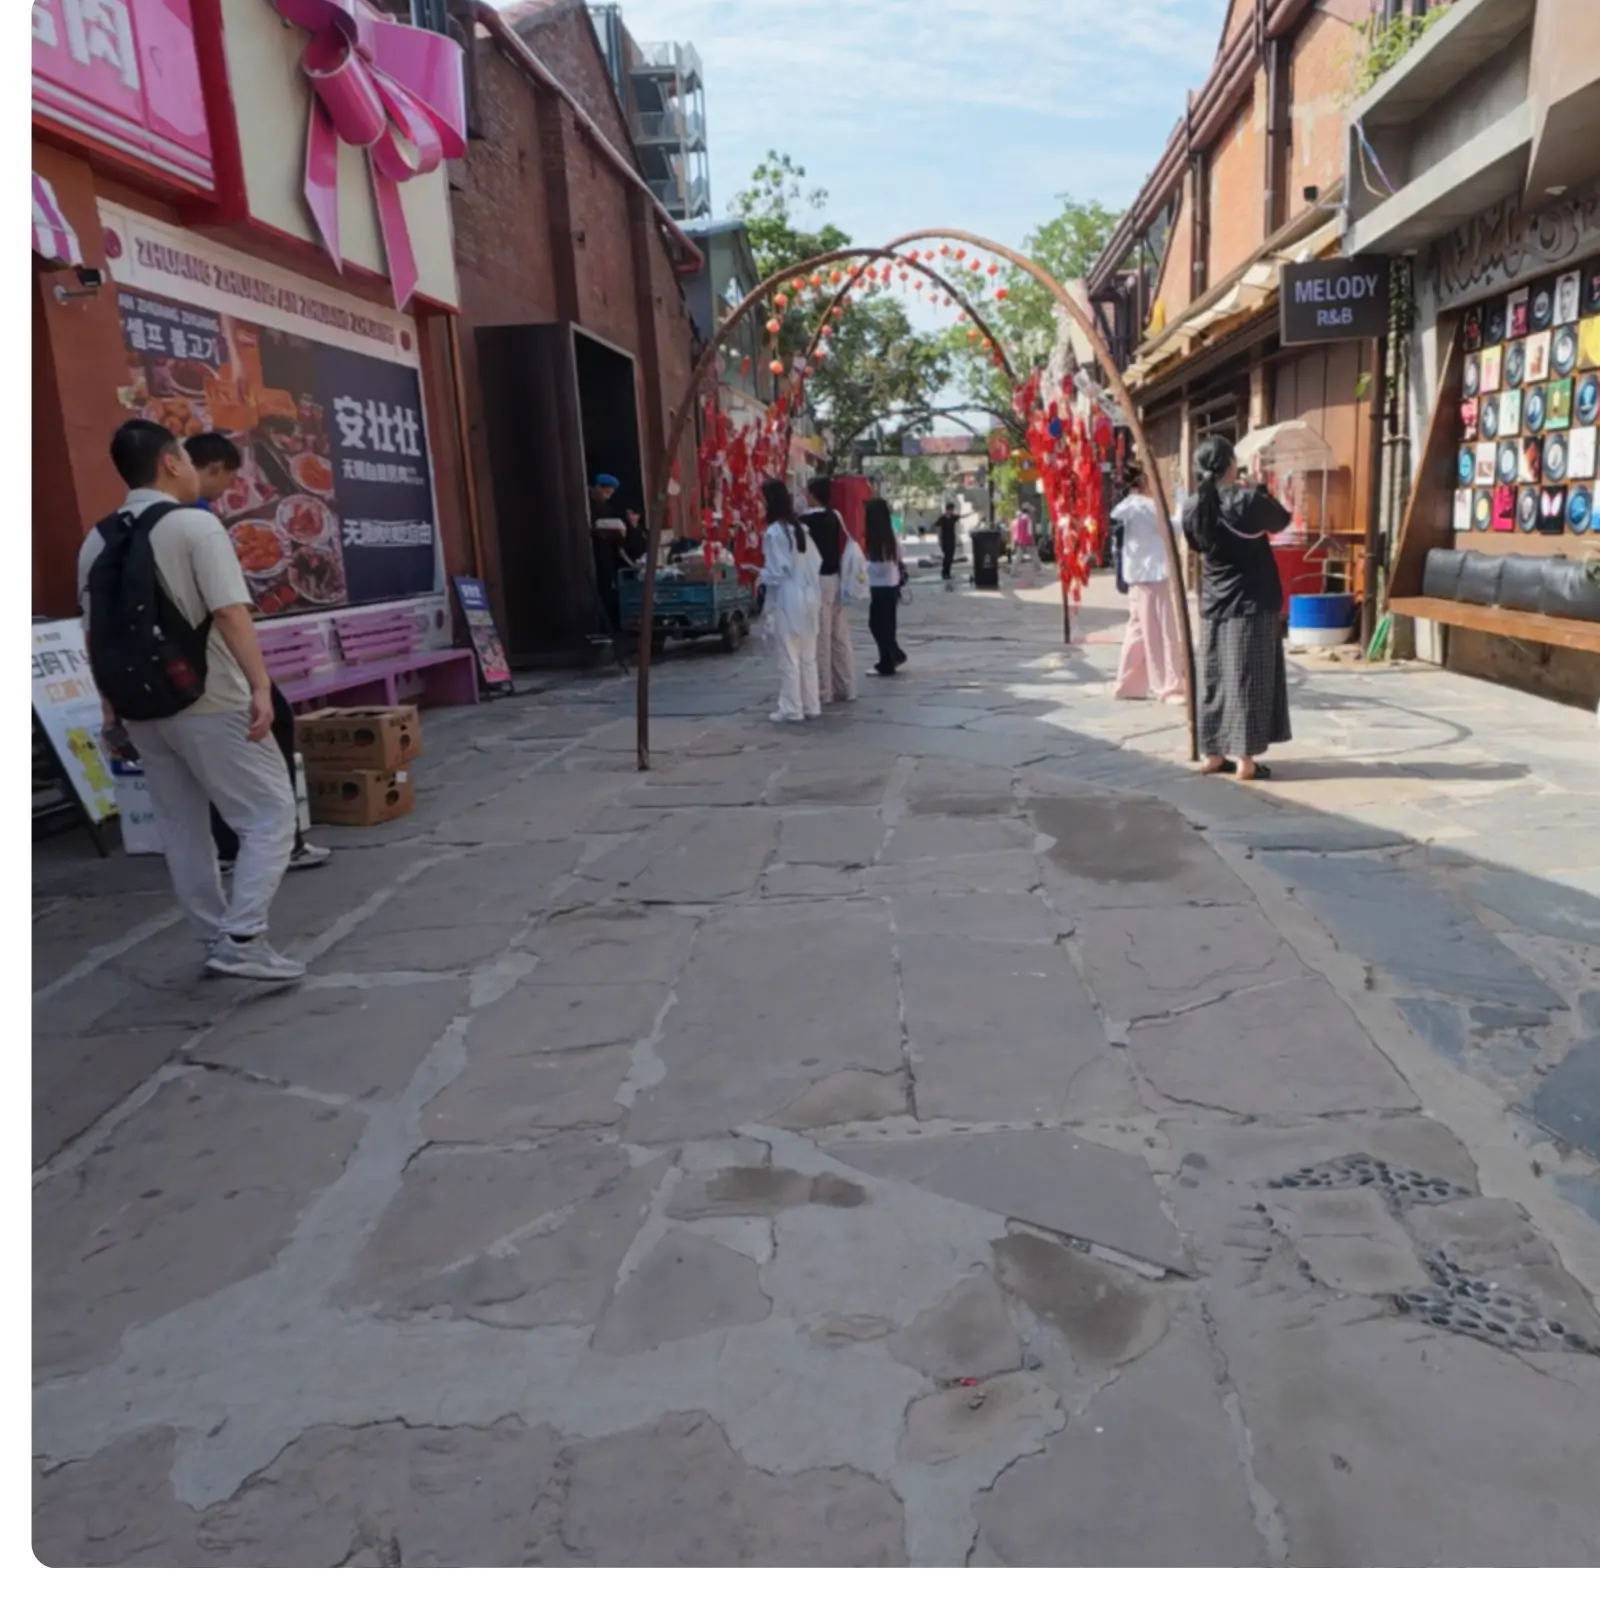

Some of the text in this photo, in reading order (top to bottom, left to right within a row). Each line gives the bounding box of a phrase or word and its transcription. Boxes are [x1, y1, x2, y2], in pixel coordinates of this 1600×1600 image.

[135, 236, 211, 287] ZHUANG
[214, 264, 276, 307] ZHUANG
[299, 296, 350, 331] ZHUANG
[1294, 273, 1379, 303] MELODY
[126, 317, 221, 366] 셀프 불고기
[1316, 307, 1353, 327] R&B
[333, 395, 422, 457] 安壮壮
